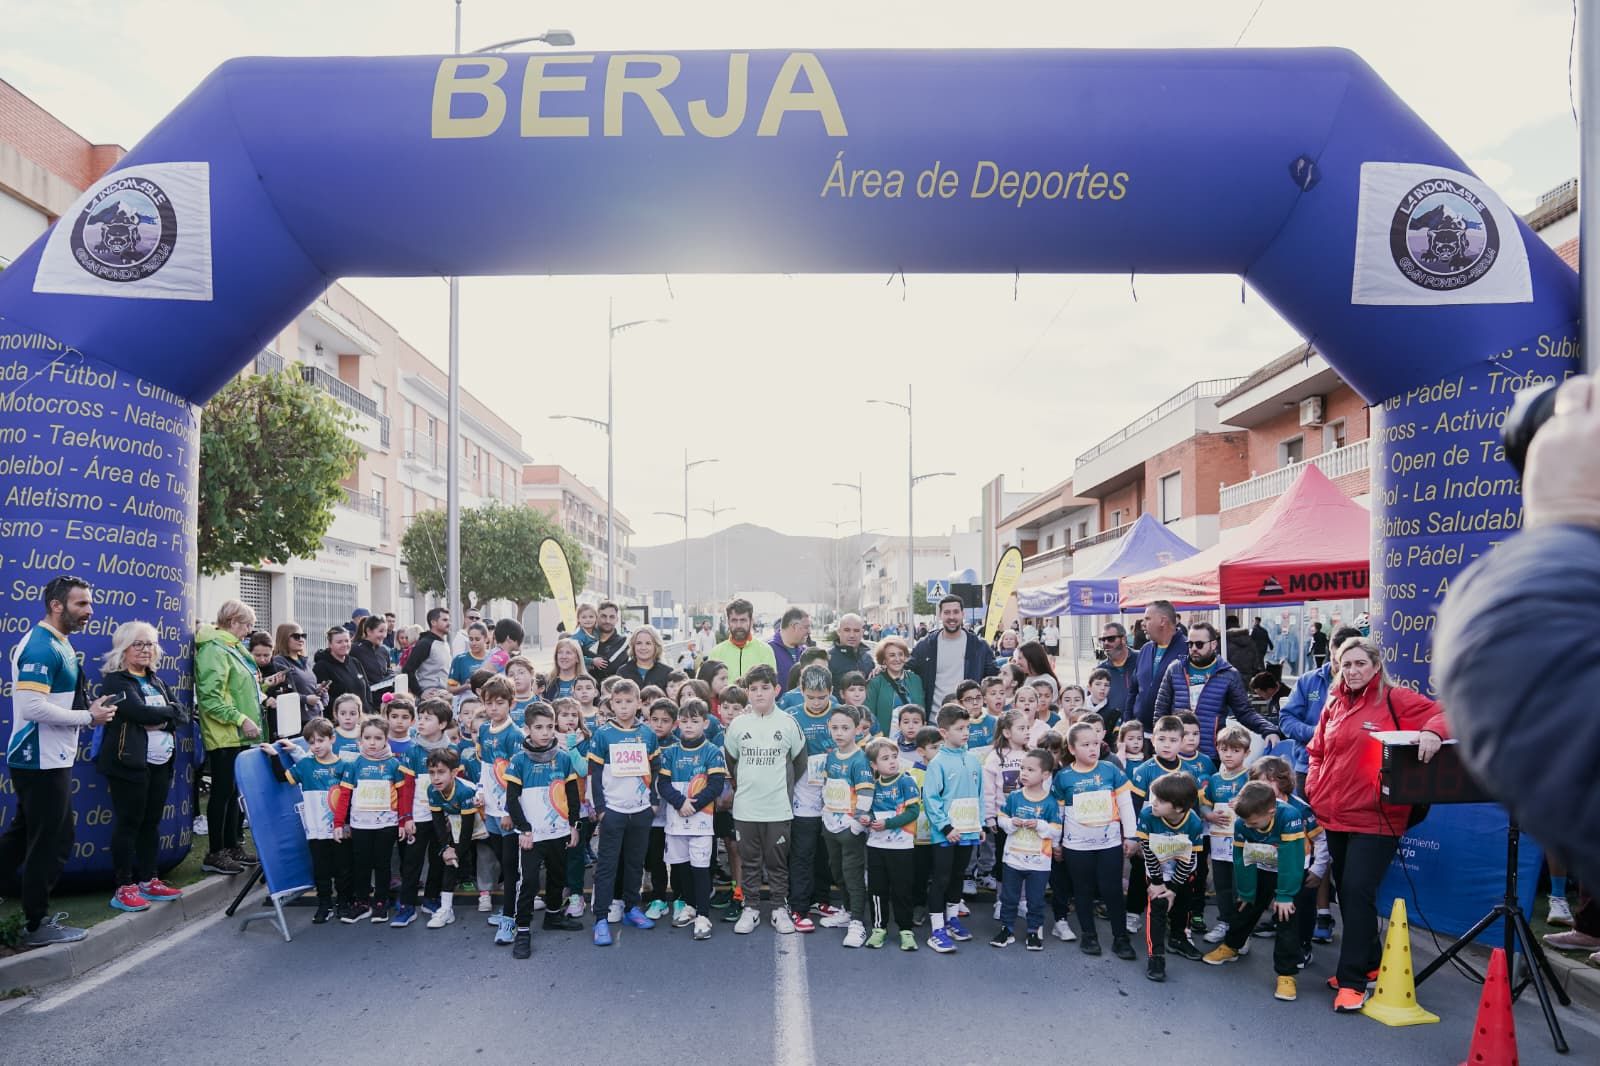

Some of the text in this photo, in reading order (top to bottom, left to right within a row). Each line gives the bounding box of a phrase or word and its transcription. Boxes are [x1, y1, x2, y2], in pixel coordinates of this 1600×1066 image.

[431, 52, 848, 139] BERJA
[820, 150, 1130, 208] Área de Deportes
[49, 362, 118, 390] Fútbol
[50, 424, 163, 459] Taekwondo
[84, 456, 134, 484] Área
[139, 468, 161, 489] de
[1391, 446, 1436, 477] Open
[1443, 444, 1470, 467] de
[5, 486, 103, 511] Atletismo
[1413, 481, 1437, 503] La
[65, 519, 158, 549] Escalada
[22, 548, 76, 571] Judo
[1385, 551, 1402, 569] de
[1407, 543, 1465, 568] Pádel
[1289, 569, 1369, 593] MONTU
[1391, 610, 1437, 637] Open
[616, 750, 643, 764] 2345
[86, 805, 113, 826] de
